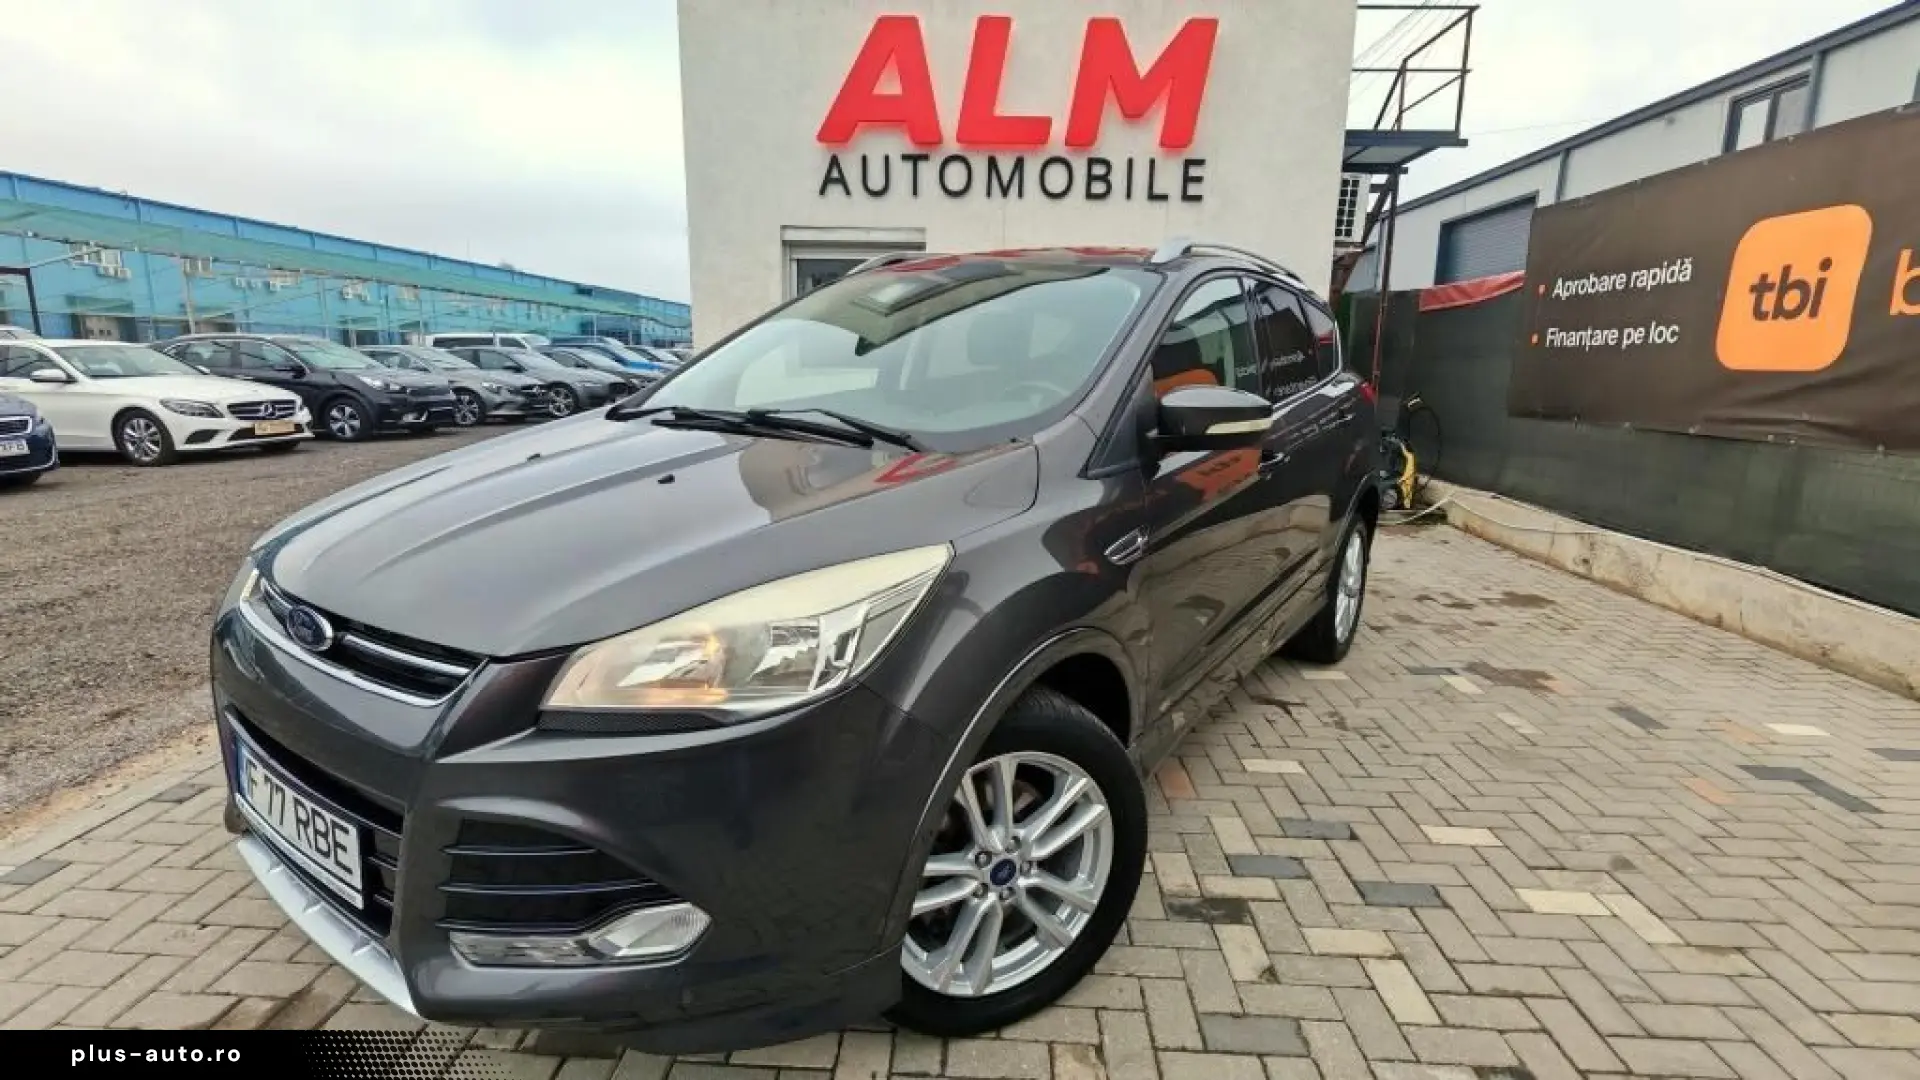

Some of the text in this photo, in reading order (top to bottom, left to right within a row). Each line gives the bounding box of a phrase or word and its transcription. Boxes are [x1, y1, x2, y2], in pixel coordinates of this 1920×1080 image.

[816, 15, 1219, 148] ALM
[819, 153, 1207, 202] AUTOMOBILE
[1552, 257, 1694, 300] Aprobare rapidă
[1749, 256, 1833, 321] tbi
[1545, 321, 1680, 352] Finanțare pe loc
[264, 773, 286, 826] 77
[293, 795, 353, 875] RBE
